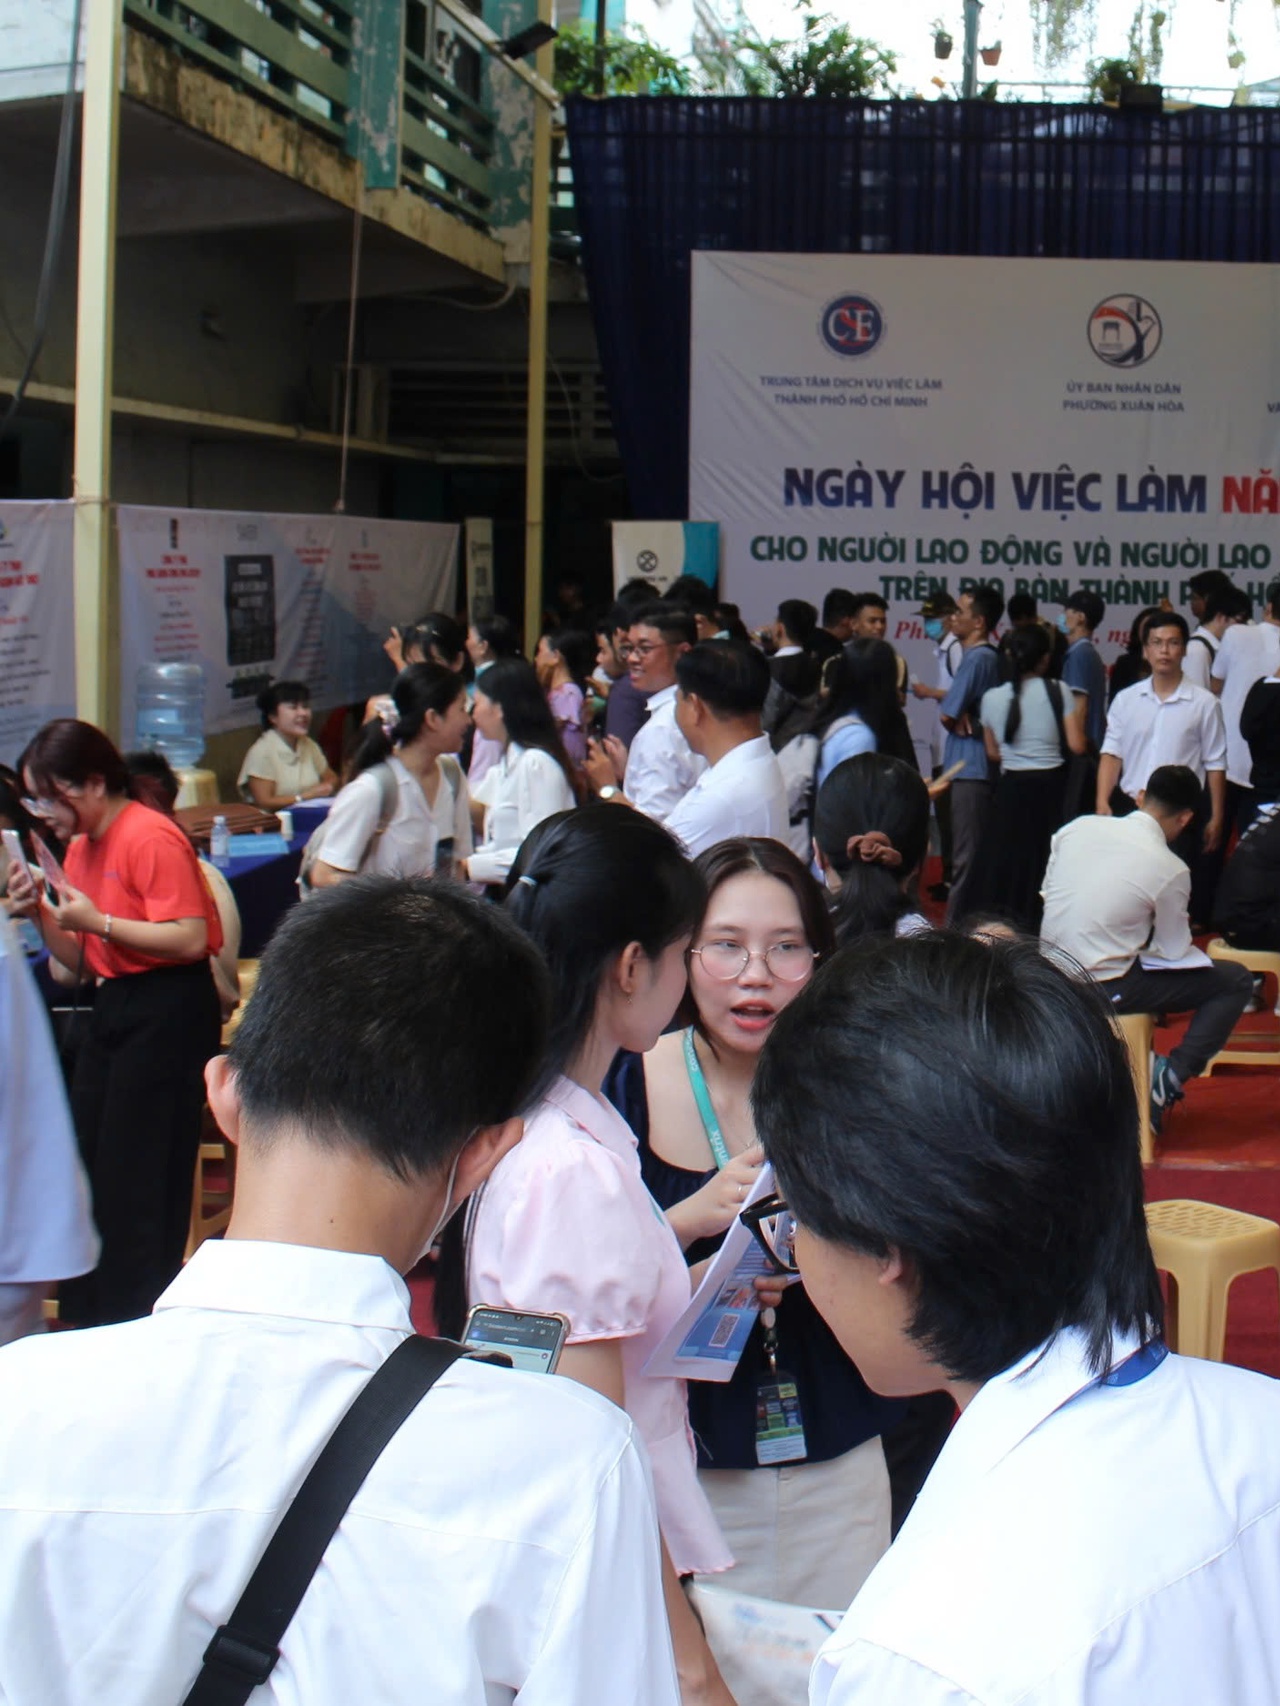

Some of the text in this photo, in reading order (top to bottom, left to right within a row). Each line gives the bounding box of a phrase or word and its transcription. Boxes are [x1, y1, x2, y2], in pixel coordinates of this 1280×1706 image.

[760, 374, 943, 391] TRUNG TÂM DỊCH VỤ VIỆC LÀM
[1086, 382, 1113, 394] BAN
[1115, 380, 1152, 394] NHÂN
[1154, 382, 1182, 395] DÂN
[774, 392, 817, 406] THÀNH
[871, 394, 892, 408] CHÍ
[894, 396, 929, 408] MINH
[1063, 397, 1185, 412] PHƯỜNG XUÂN HÒA
[783, 460, 906, 509] NGÀY
[920, 462, 996, 520] HỘI
[1011, 464, 1103, 522] VIỆC
[1116, 465, 1207, 514] LÀM
[749, 535, 808, 562] CHO
[817, 531, 907, 563] NGƯỜI
[915, 537, 970, 564] LAO
[979, 533, 1063, 572] ĐỘNG
[1073, 534, 1112, 567] VÀ
[1120, 536, 1209, 569] NGƯỜI
[1217, 543, 1271, 570] LAO
[879, 570, 948, 601] TRÊN
[1078, 572, 1169, 606] THÀNH
